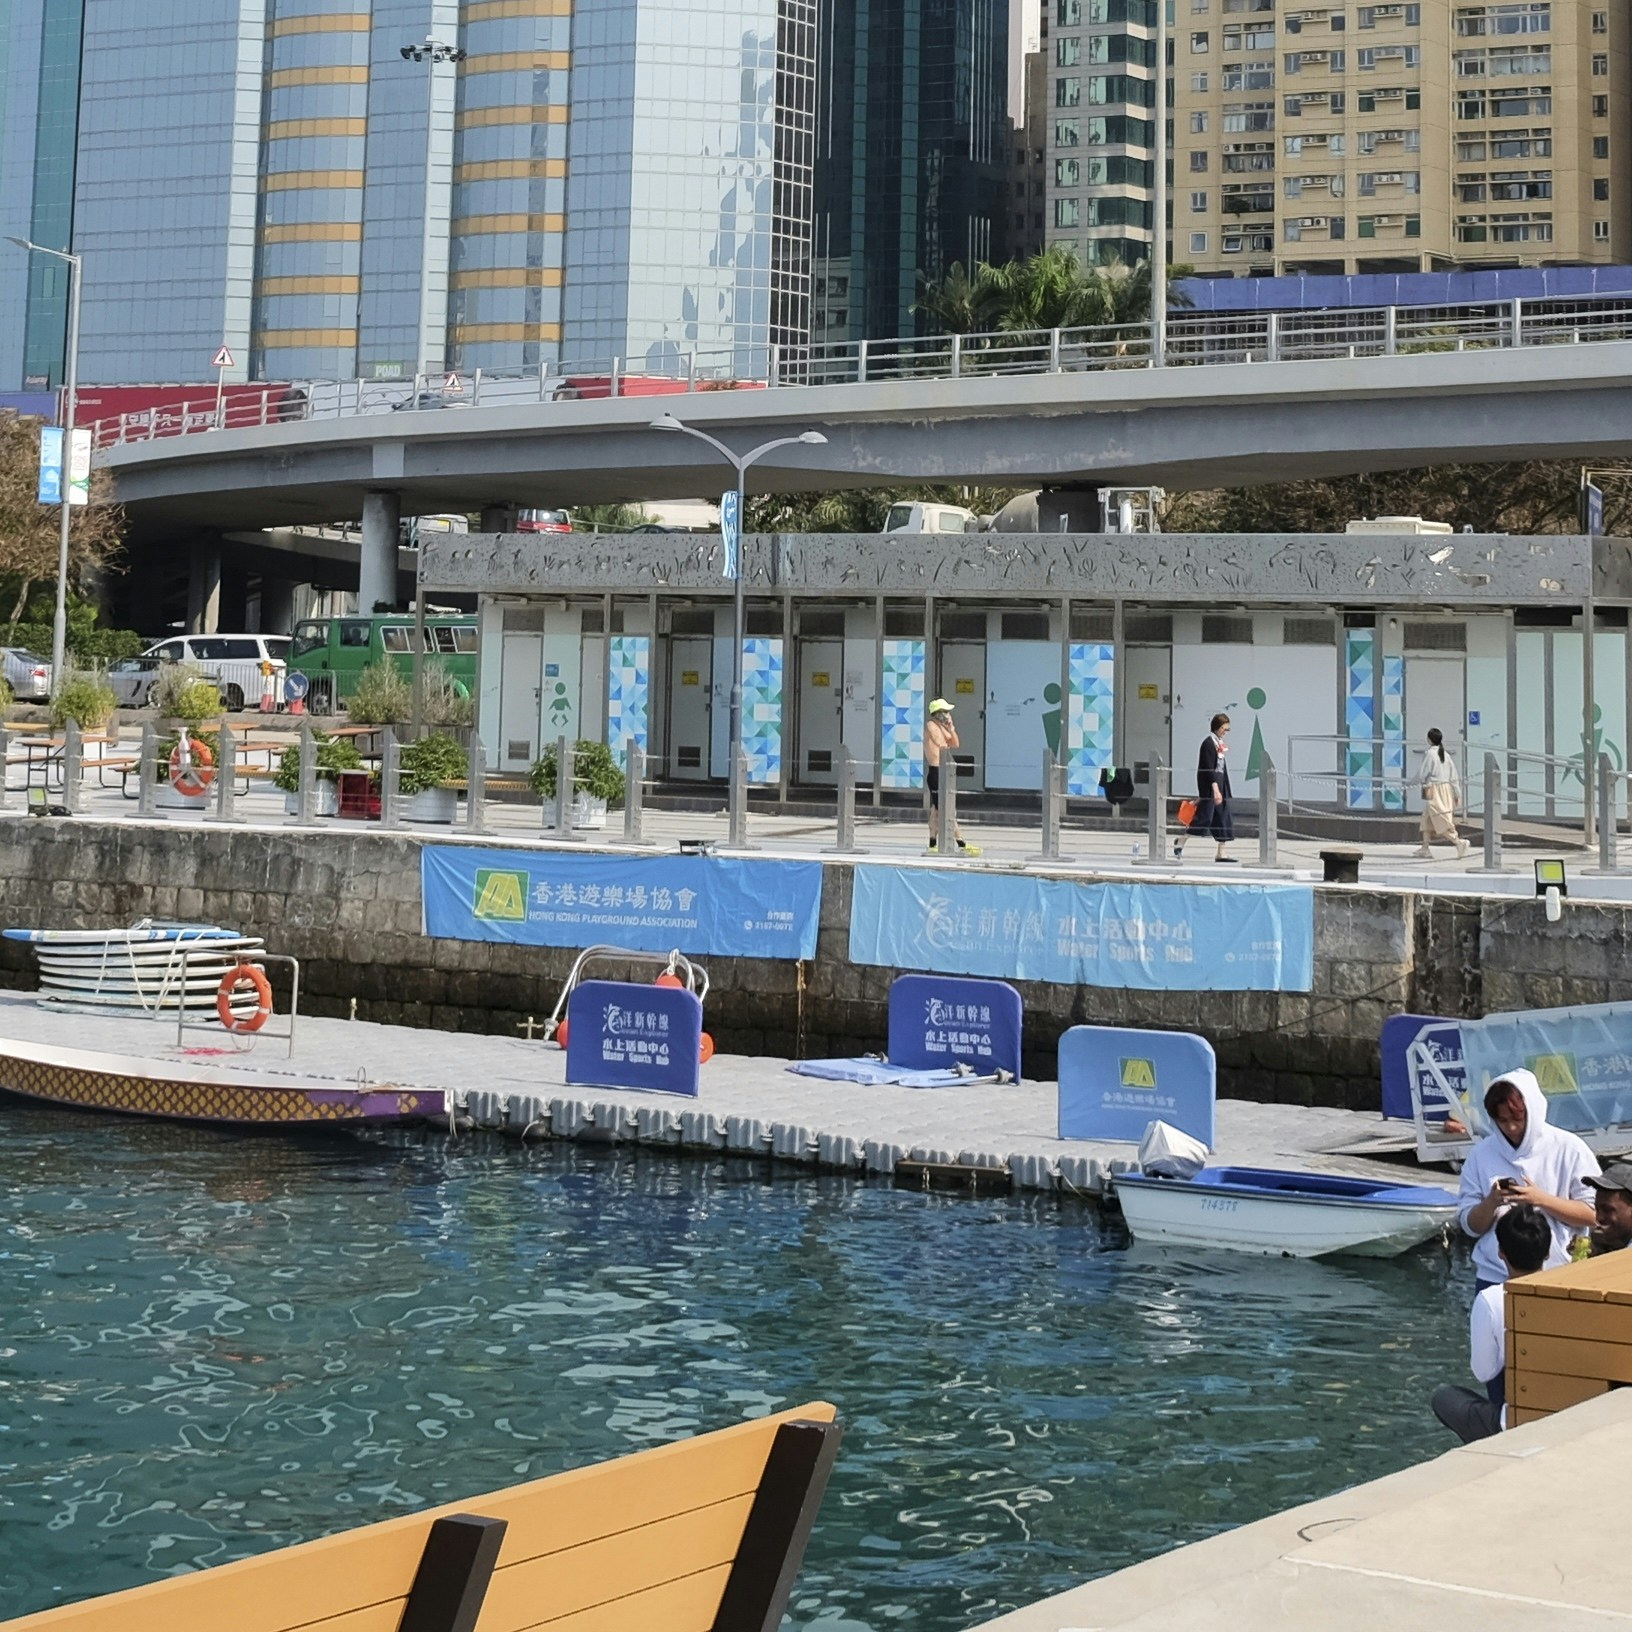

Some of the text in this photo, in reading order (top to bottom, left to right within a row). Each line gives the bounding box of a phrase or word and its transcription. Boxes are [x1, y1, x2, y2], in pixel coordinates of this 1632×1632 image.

[375, 364, 400, 377] POAD
[532, 881, 697, 912] 香港遊樂場協會
[529, 910, 697, 929] HONG KONG PLAYGROUND ASSOCIATION
[1058, 915, 1193, 942] 水上活動中心
[1057, 939, 1194, 963] Water Sports Hub
[925, 1029, 991, 1045] 水上活動中心
[603, 1038, 670, 1055] 水上活動中心
[925, 1042, 992, 1056] Water Sports Hub
[603, 1050, 670, 1065] Water Sports Hub
[1582, 1082, 1608, 1092] HONG
